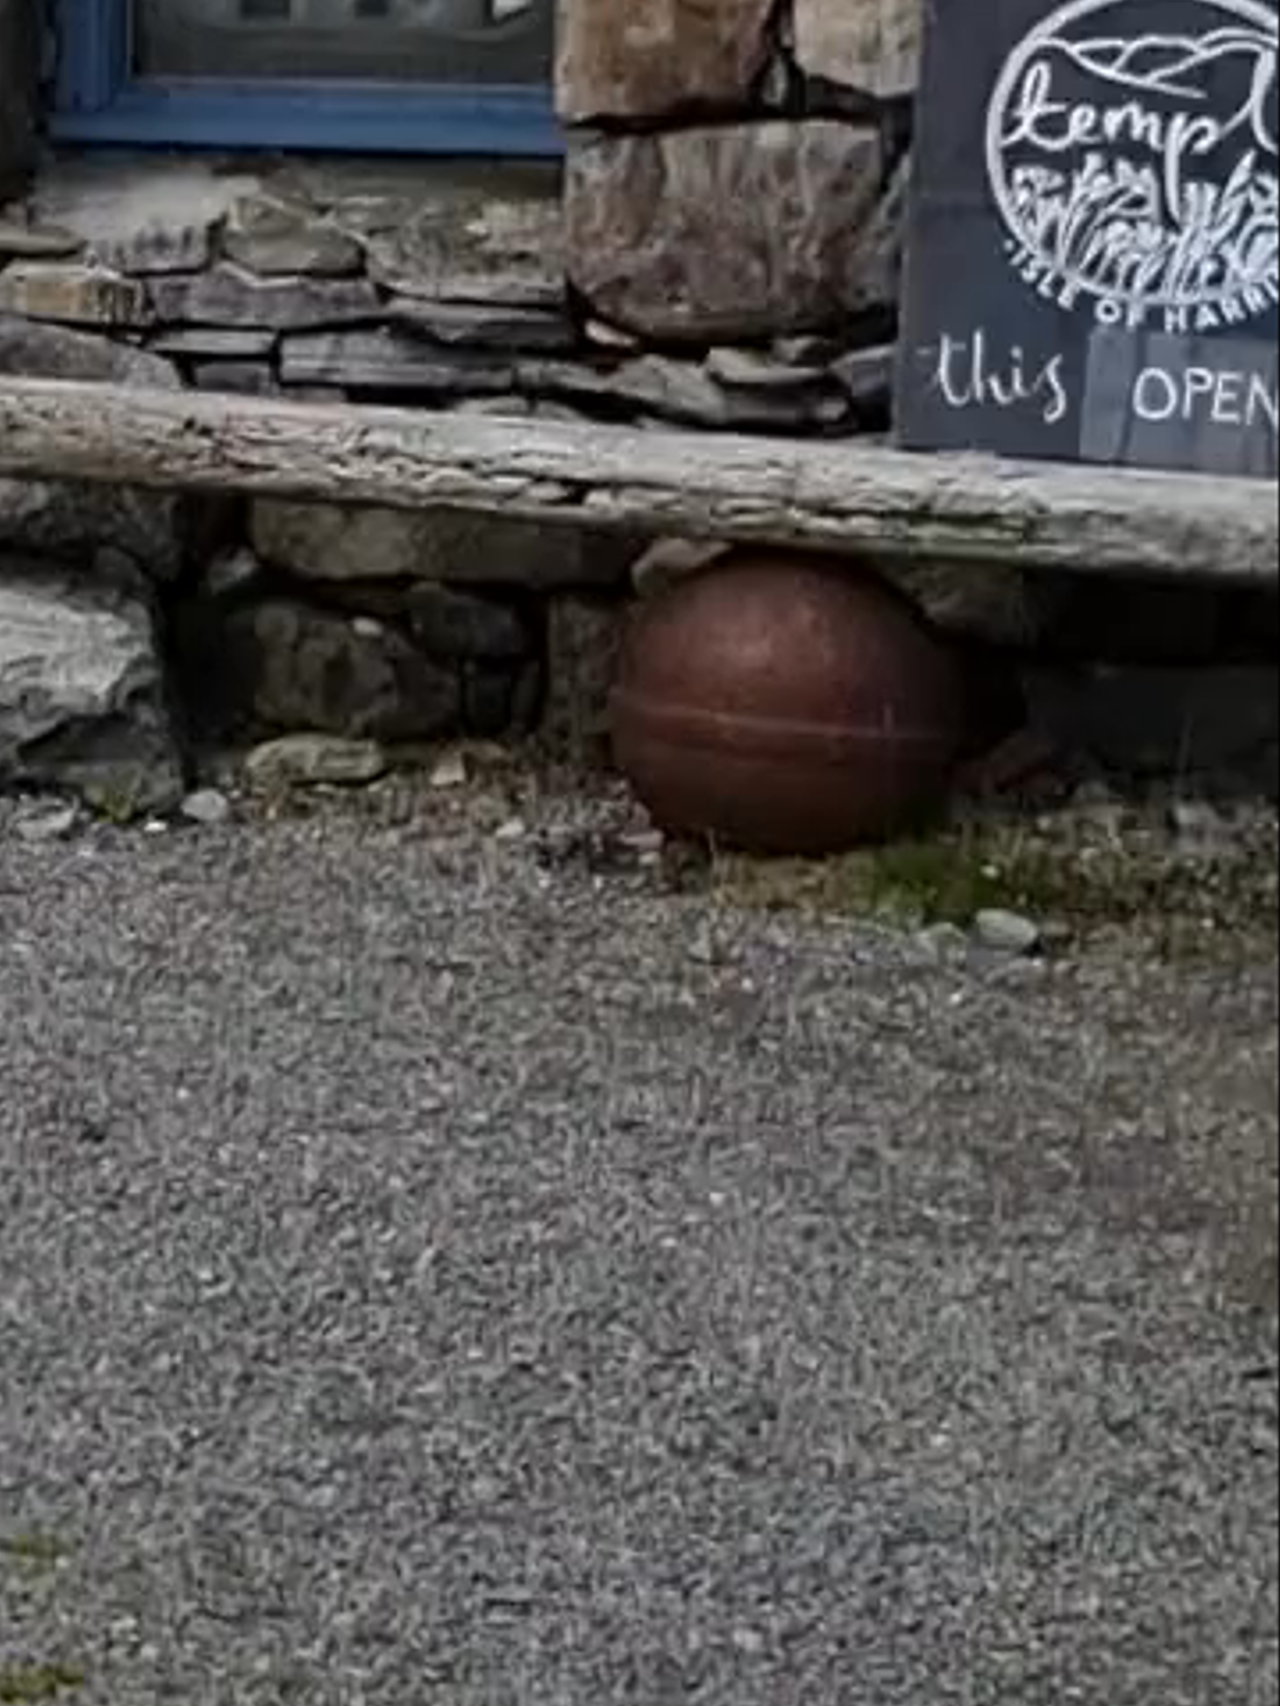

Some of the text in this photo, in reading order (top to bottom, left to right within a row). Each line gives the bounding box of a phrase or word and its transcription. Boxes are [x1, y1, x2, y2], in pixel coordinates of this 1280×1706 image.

[1094, 298, 1145, 329] OF
[916, 328, 1067, 424] this
[1132, 366, 1278, 428] OPEN
